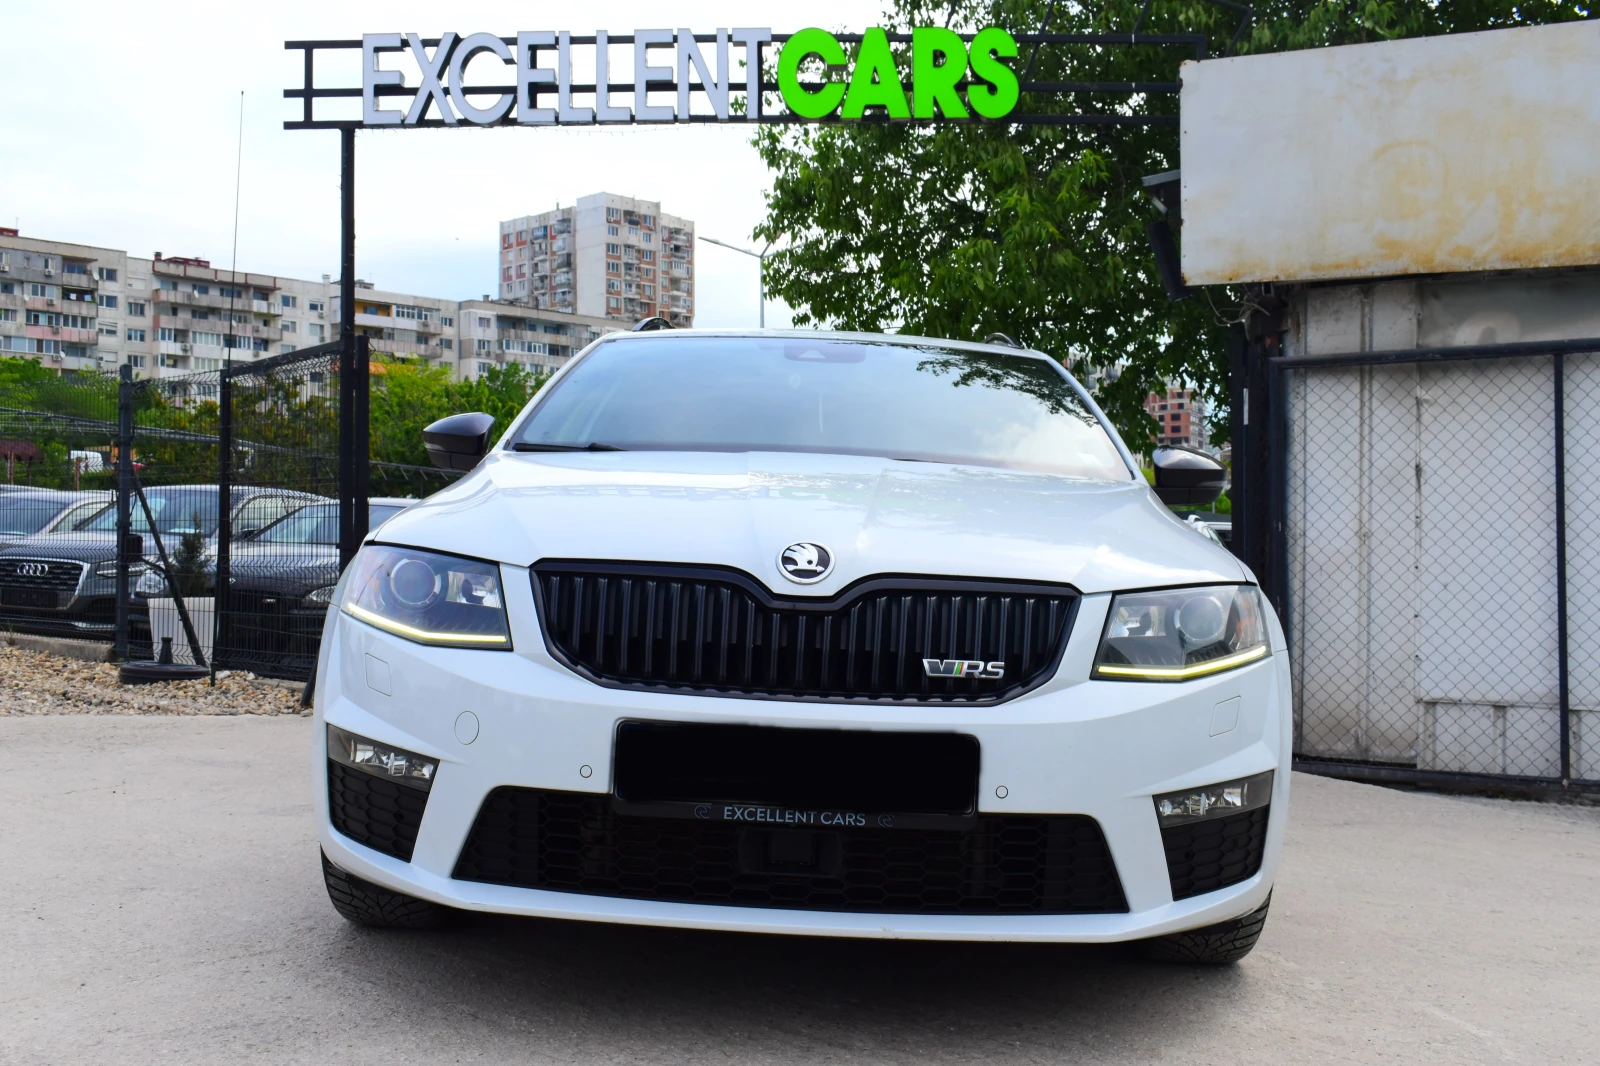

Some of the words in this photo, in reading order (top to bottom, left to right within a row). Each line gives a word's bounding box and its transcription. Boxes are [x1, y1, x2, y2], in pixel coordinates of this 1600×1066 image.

[361, 28, 771, 126] EXCELLENT
[777, 27, 1020, 120] CARS
[723, 805, 817, 824] EXCELLENT
[820, 811, 866, 826] CARS
